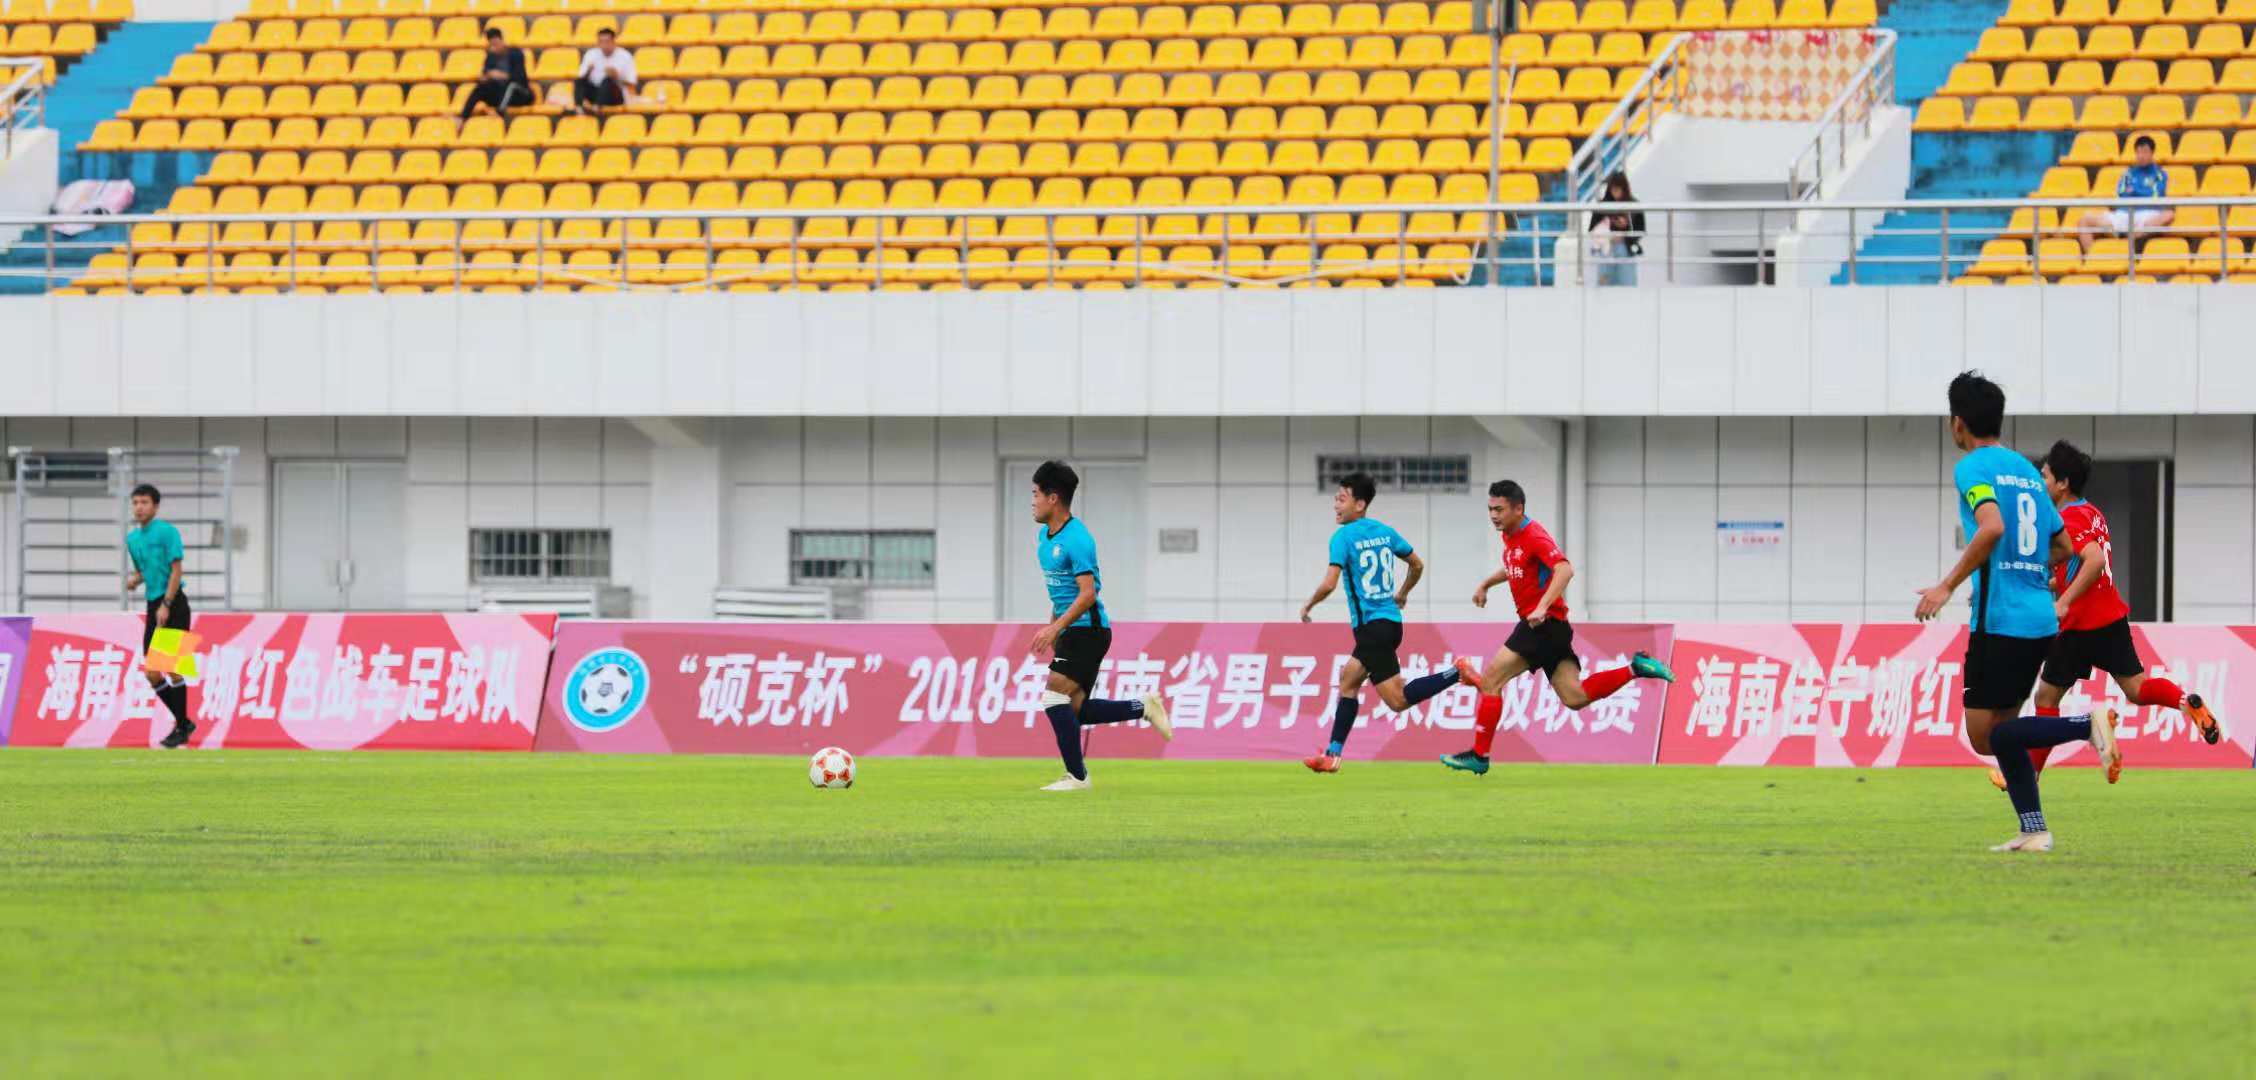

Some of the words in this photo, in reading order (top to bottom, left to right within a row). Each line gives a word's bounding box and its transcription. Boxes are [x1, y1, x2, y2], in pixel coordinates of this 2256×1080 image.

[2017, 493, 2038, 556] 8
[1360, 547, 1392, 595] 28
[38, 643, 520, 723] 海南佳娜红色战车足球队
[680, 653, 882, 727] “硕克杯”
